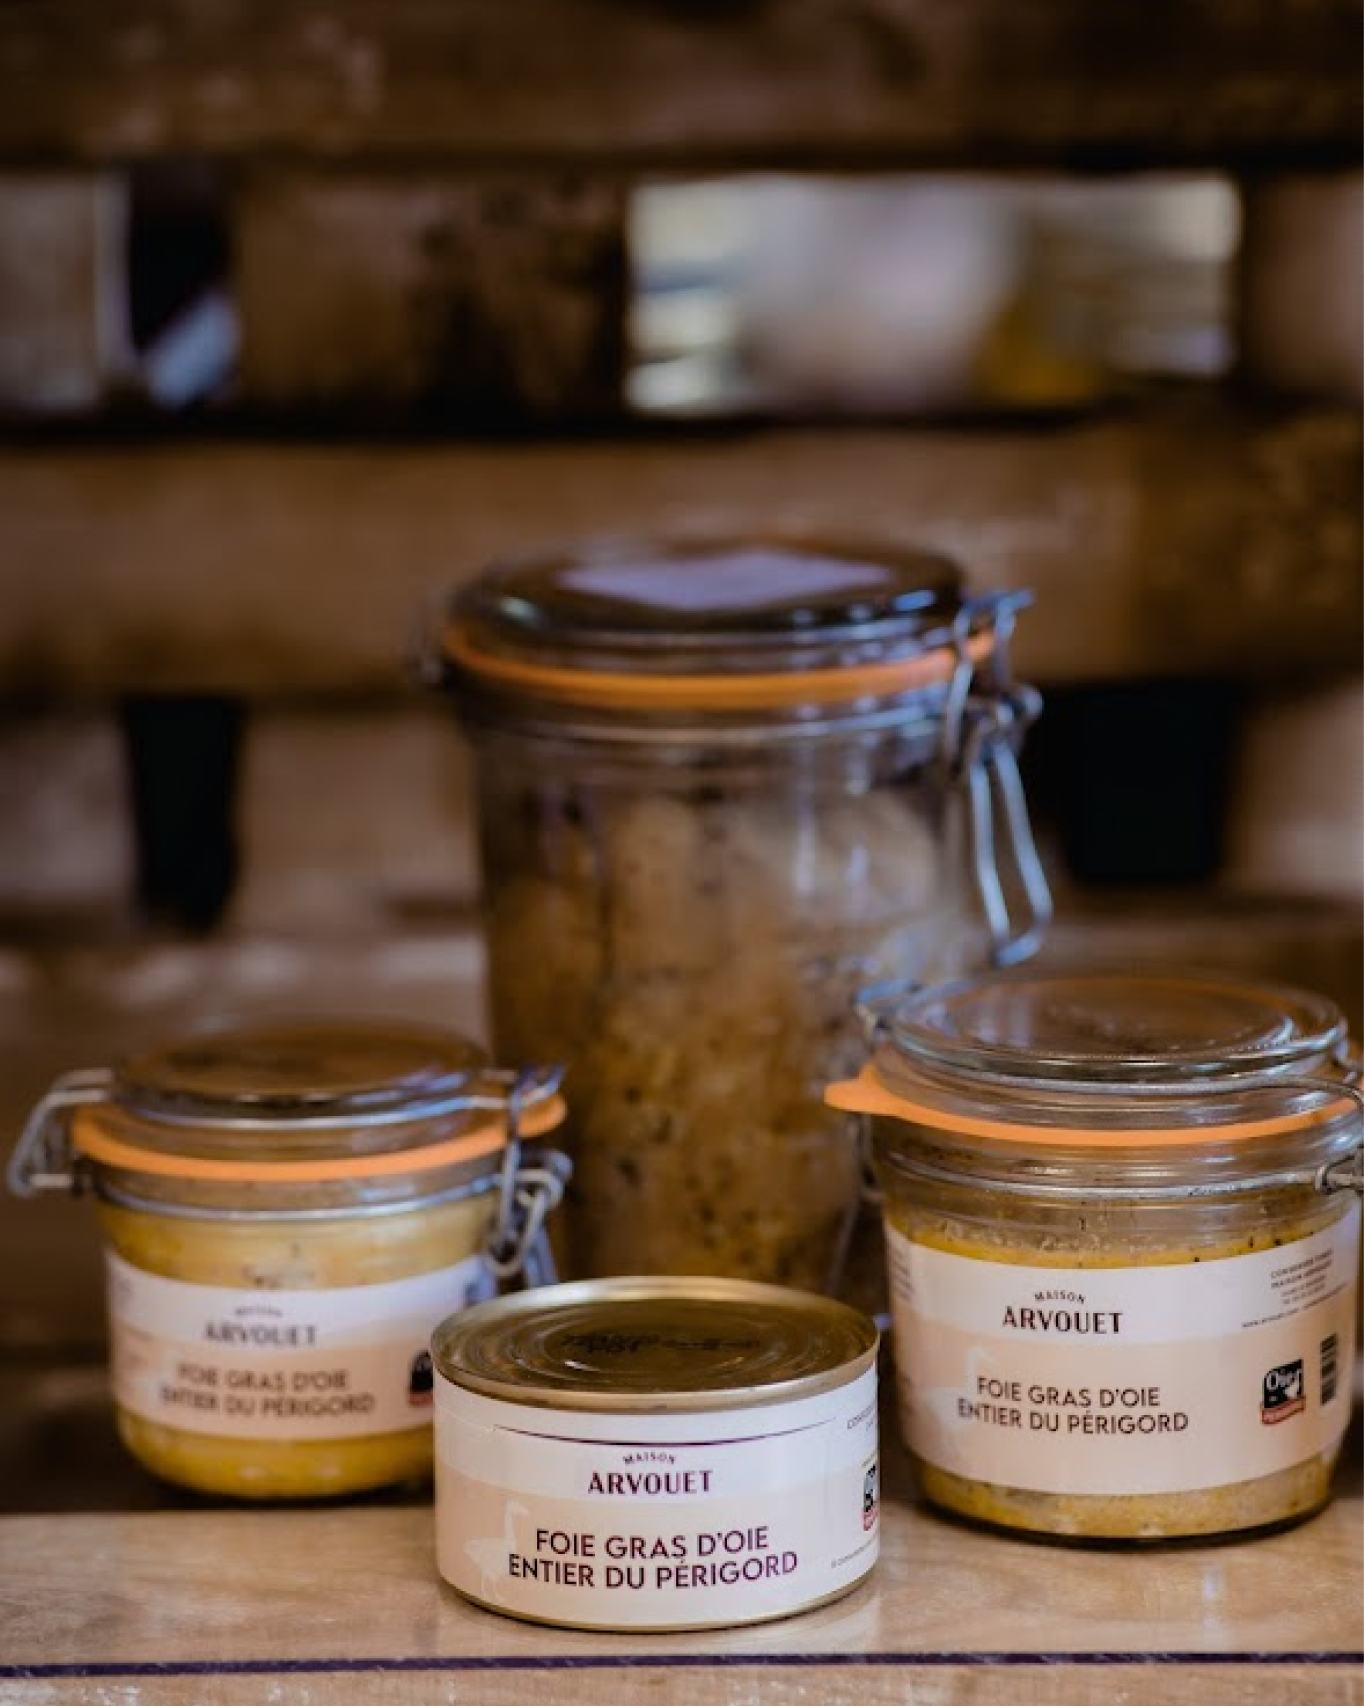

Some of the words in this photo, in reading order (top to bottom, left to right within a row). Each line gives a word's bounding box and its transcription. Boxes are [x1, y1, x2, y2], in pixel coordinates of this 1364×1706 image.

[1034, 1289, 1086, 1304] MAISON
[1002, 1305, 1124, 1334] ARVOUET
[226, 1370, 285, 1391] GRAS
[977, 1375, 1022, 1402] FOIE
[1028, 1385, 1092, 1408] GRAS
[1099, 1387, 1161, 1408] D'OIE
[226, 1394, 255, 1415] DU
[957, 1396, 1022, 1429] ENTIER
[1029, 1411, 1059, 1432] DU
[1067, 1409, 1189, 1434] PÉRIGORD
[622, 1450, 677, 1465] MAISON
[587, 1470, 713, 1495] ARVOUET
[536, 1528, 596, 1556] FOIE
[605, 1535, 688, 1561] GRAS
[697, 1526, 770, 1557] D'OIE
[508, 1553, 596, 1588] ENTIER
[606, 1565, 645, 1590] DU
[656, 1551, 799, 1590] PÉRIGORD
